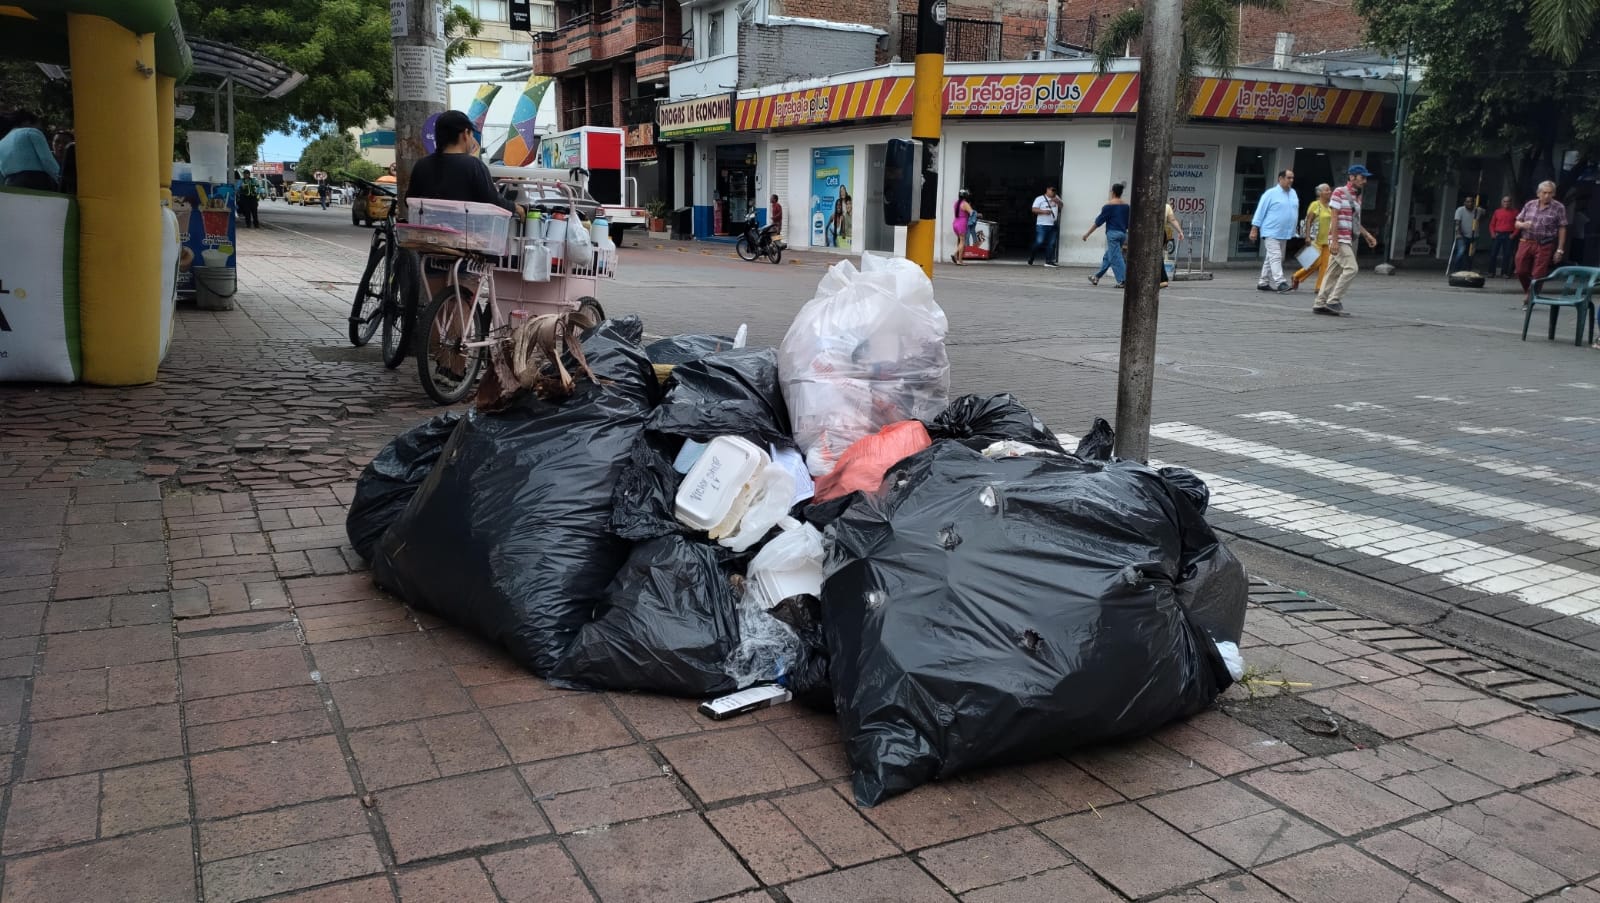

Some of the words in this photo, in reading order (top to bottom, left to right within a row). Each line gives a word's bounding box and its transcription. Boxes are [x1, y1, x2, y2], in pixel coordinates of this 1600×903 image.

[783, 98, 808, 117] rebaja
[809, 92, 829, 116] plus
[951, 83, 967, 101] la
[972, 82, 1031, 108] rebaja
[1036, 80, 1081, 105] plus
[1239, 87, 1251, 106] la
[1254, 90, 1294, 113] rebaja
[1297, 92, 1326, 113] plus
[687, 105, 694, 122] LA
[695, 99, 730, 121] ECONOMIA
[1178, 198, 1205, 211] 0505
